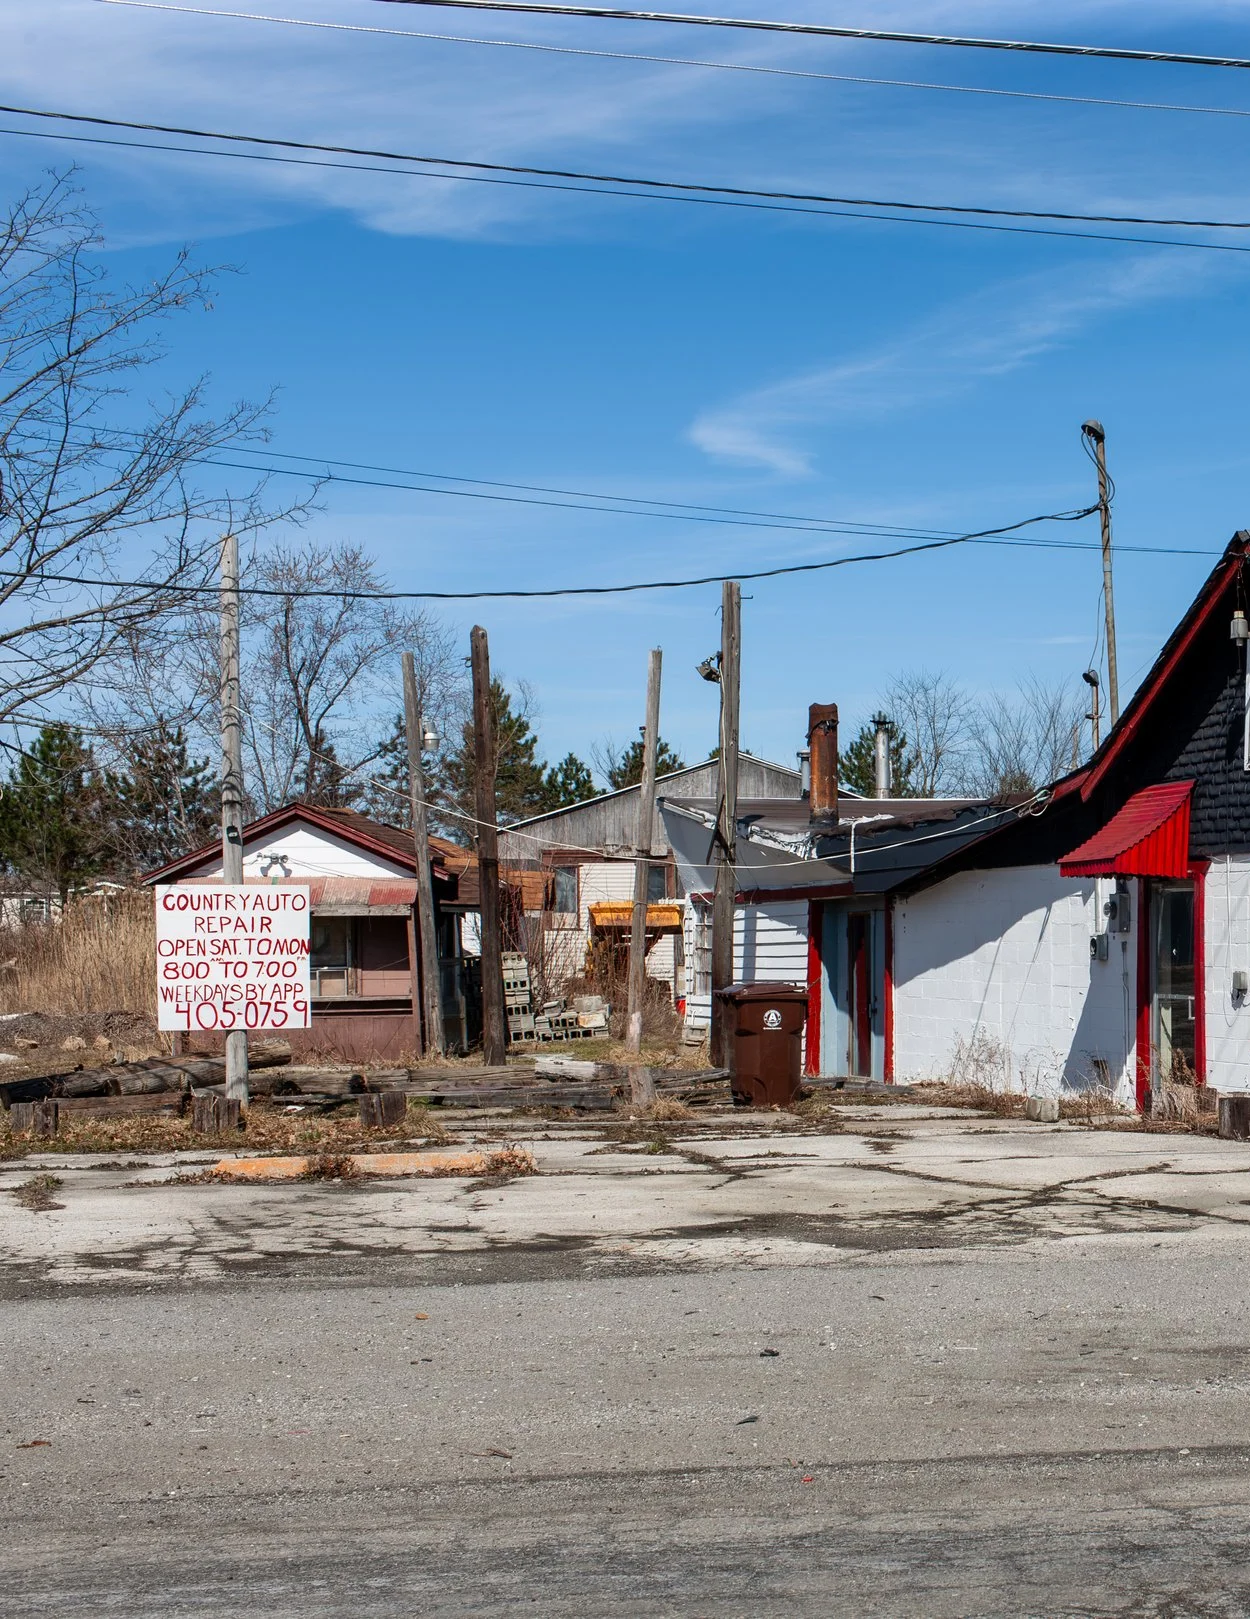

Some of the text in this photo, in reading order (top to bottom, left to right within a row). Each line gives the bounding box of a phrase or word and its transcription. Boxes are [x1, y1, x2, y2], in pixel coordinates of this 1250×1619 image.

[163, 893, 306, 911] COUNTRY AUTO
[194, 916, 272, 933] REPAIR
[158, 938, 311, 957] OPEN SAT. TO MON
[219, 961, 248, 979] TO
[252, 961, 297, 978] 7:00
[160, 983, 243, 1003] WEEKDAYS
[245, 983, 267, 1001] BY
[175, 1000, 308, 1031] 405-0759
